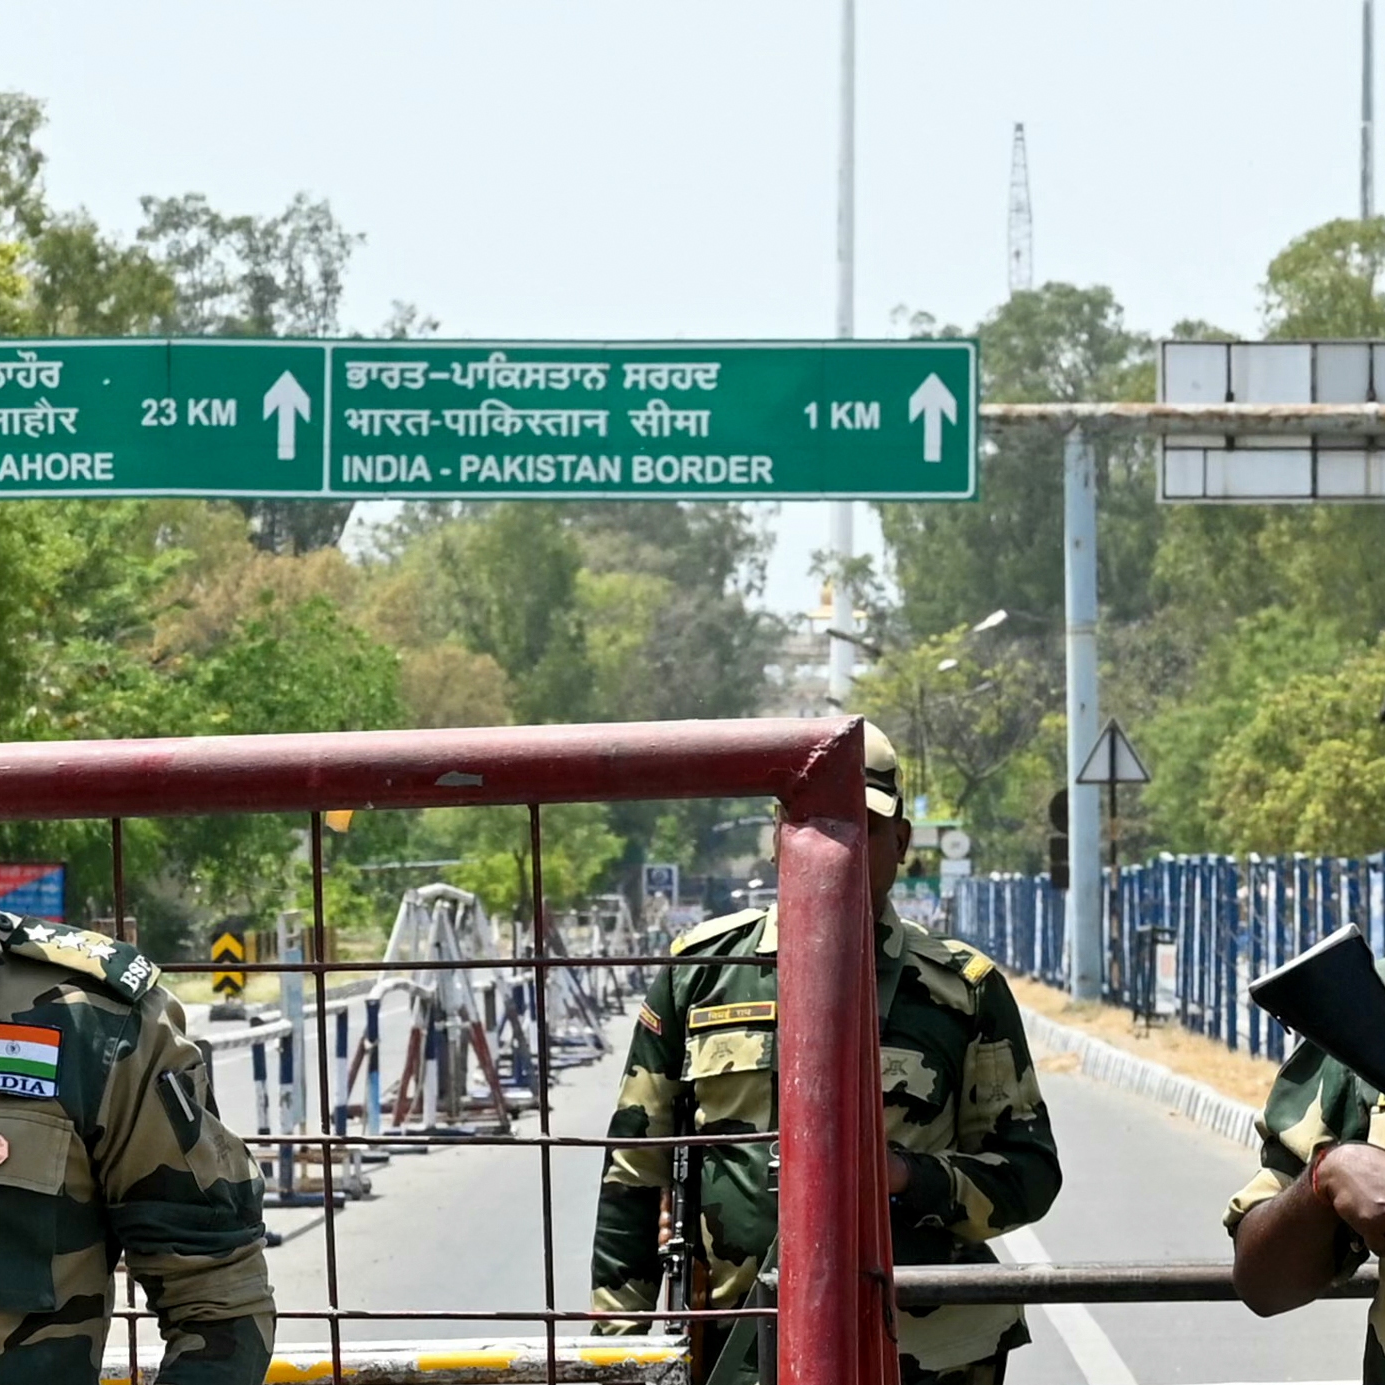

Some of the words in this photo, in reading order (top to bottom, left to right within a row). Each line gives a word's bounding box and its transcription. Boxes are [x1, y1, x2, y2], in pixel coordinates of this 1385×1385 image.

[623, 361, 721, 391] ਸਰਹਦ
[141, 398, 177, 426] 23
[187, 398, 237, 426] KM
[346, 399, 610, 438] भारत-पाकिस्तान
[628, 399, 711, 438] सीमा
[803, 402, 817, 430] 1
[830, 402, 881, 430] KM
[342, 455, 432, 483] INDIA
[459, 454, 621, 483] PAKISTAN
[631, 455, 774, 484] BORDER
[119, 952, 153, 994] BSF
